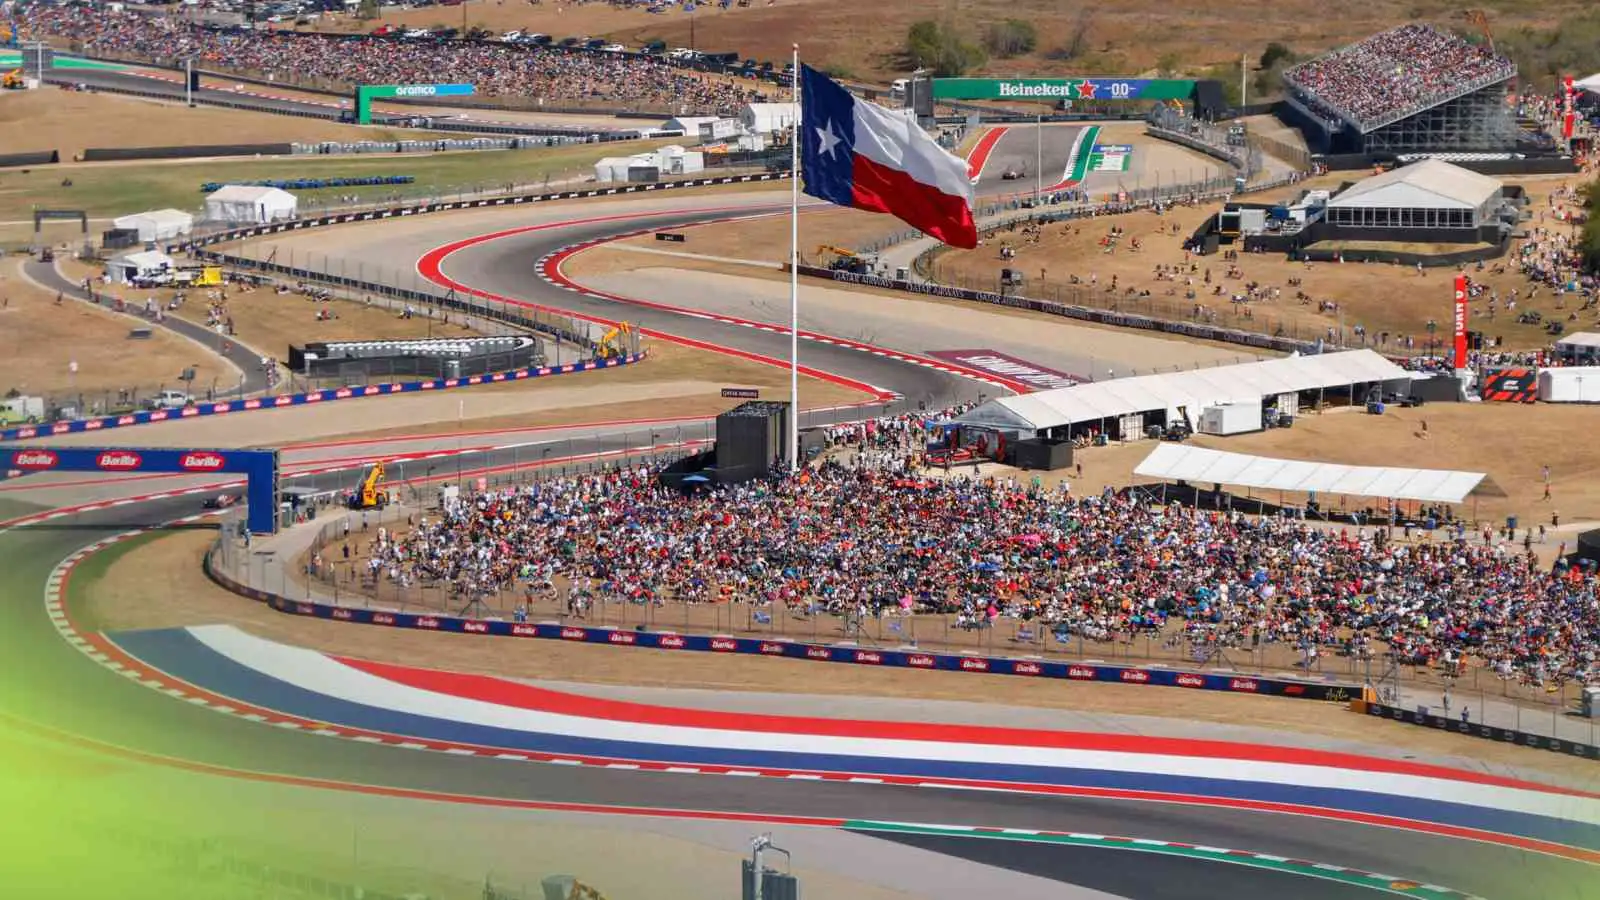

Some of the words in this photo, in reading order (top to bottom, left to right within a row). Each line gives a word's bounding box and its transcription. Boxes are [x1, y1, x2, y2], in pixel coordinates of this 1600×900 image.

[395, 86, 436, 96] aramco
[999, 82, 1070, 96] Heineken
[17, 453, 53, 465] Barilla
[101, 455, 137, 466] Barilla
[184, 456, 221, 467] Barilla
